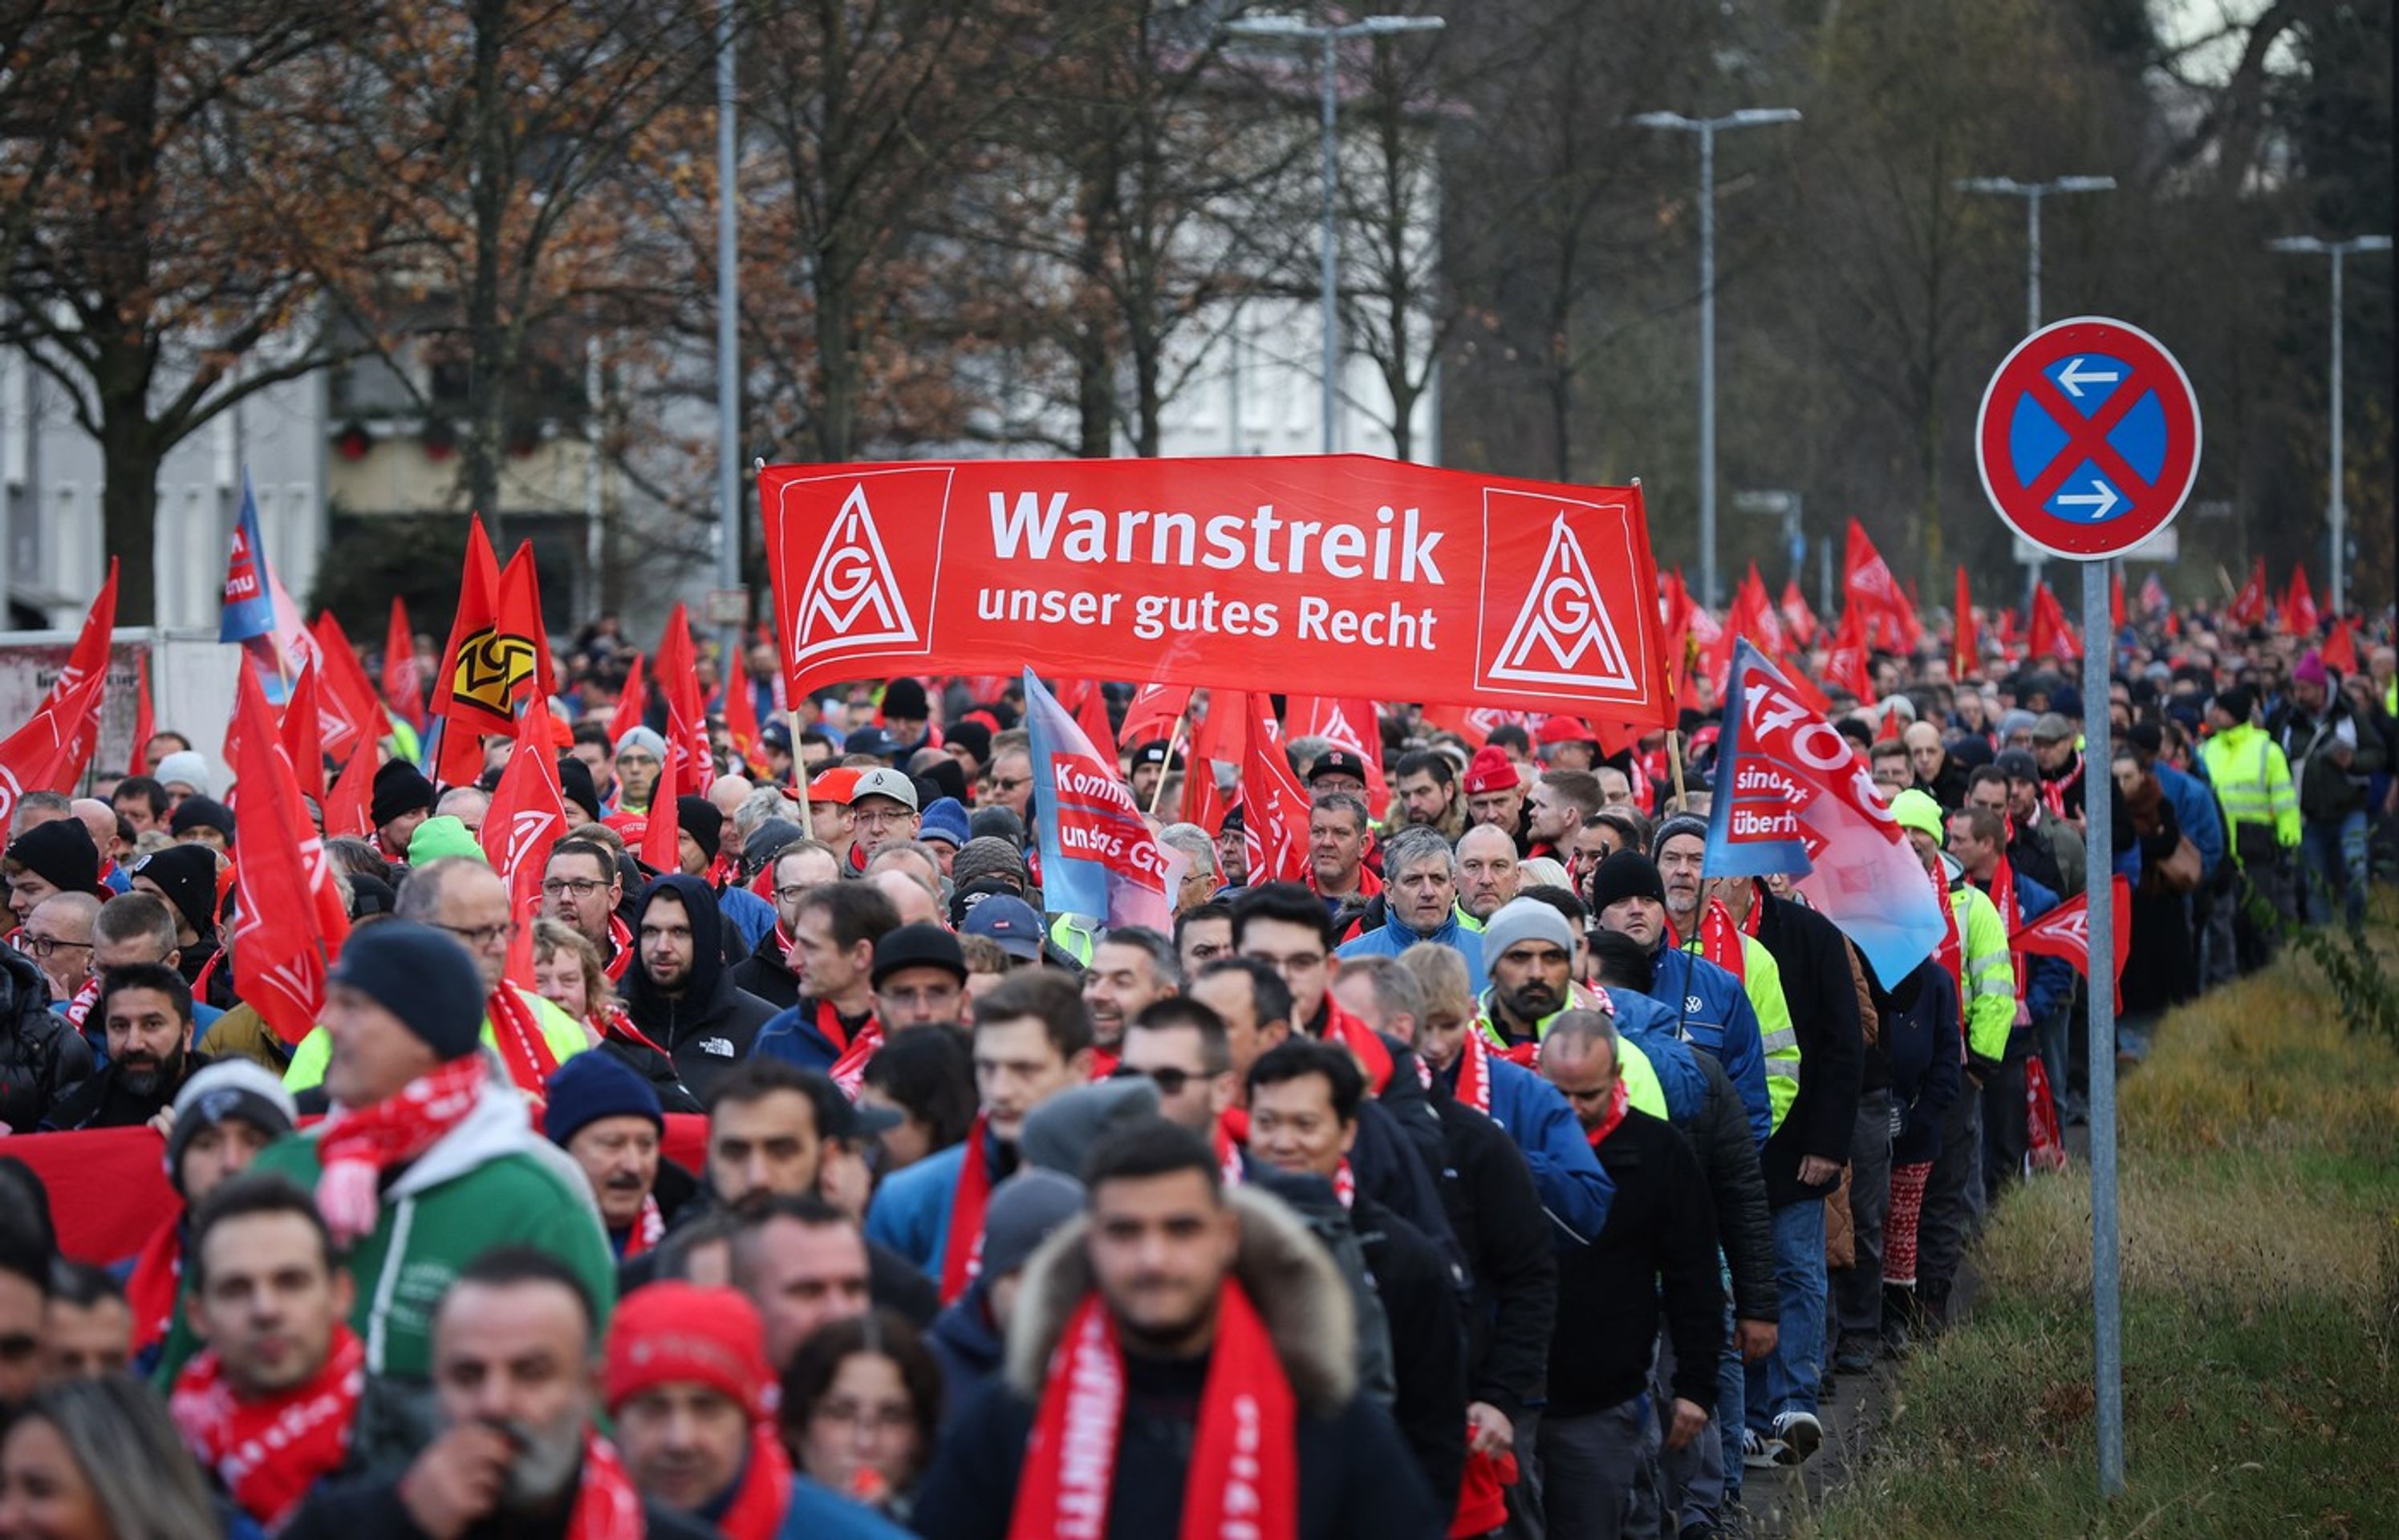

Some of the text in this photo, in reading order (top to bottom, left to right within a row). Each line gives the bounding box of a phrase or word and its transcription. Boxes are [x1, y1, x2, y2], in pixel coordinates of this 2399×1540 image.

[988, 492, 1446, 586] Warnstreik
[979, 589, 1440, 651] unser gutes Recht
